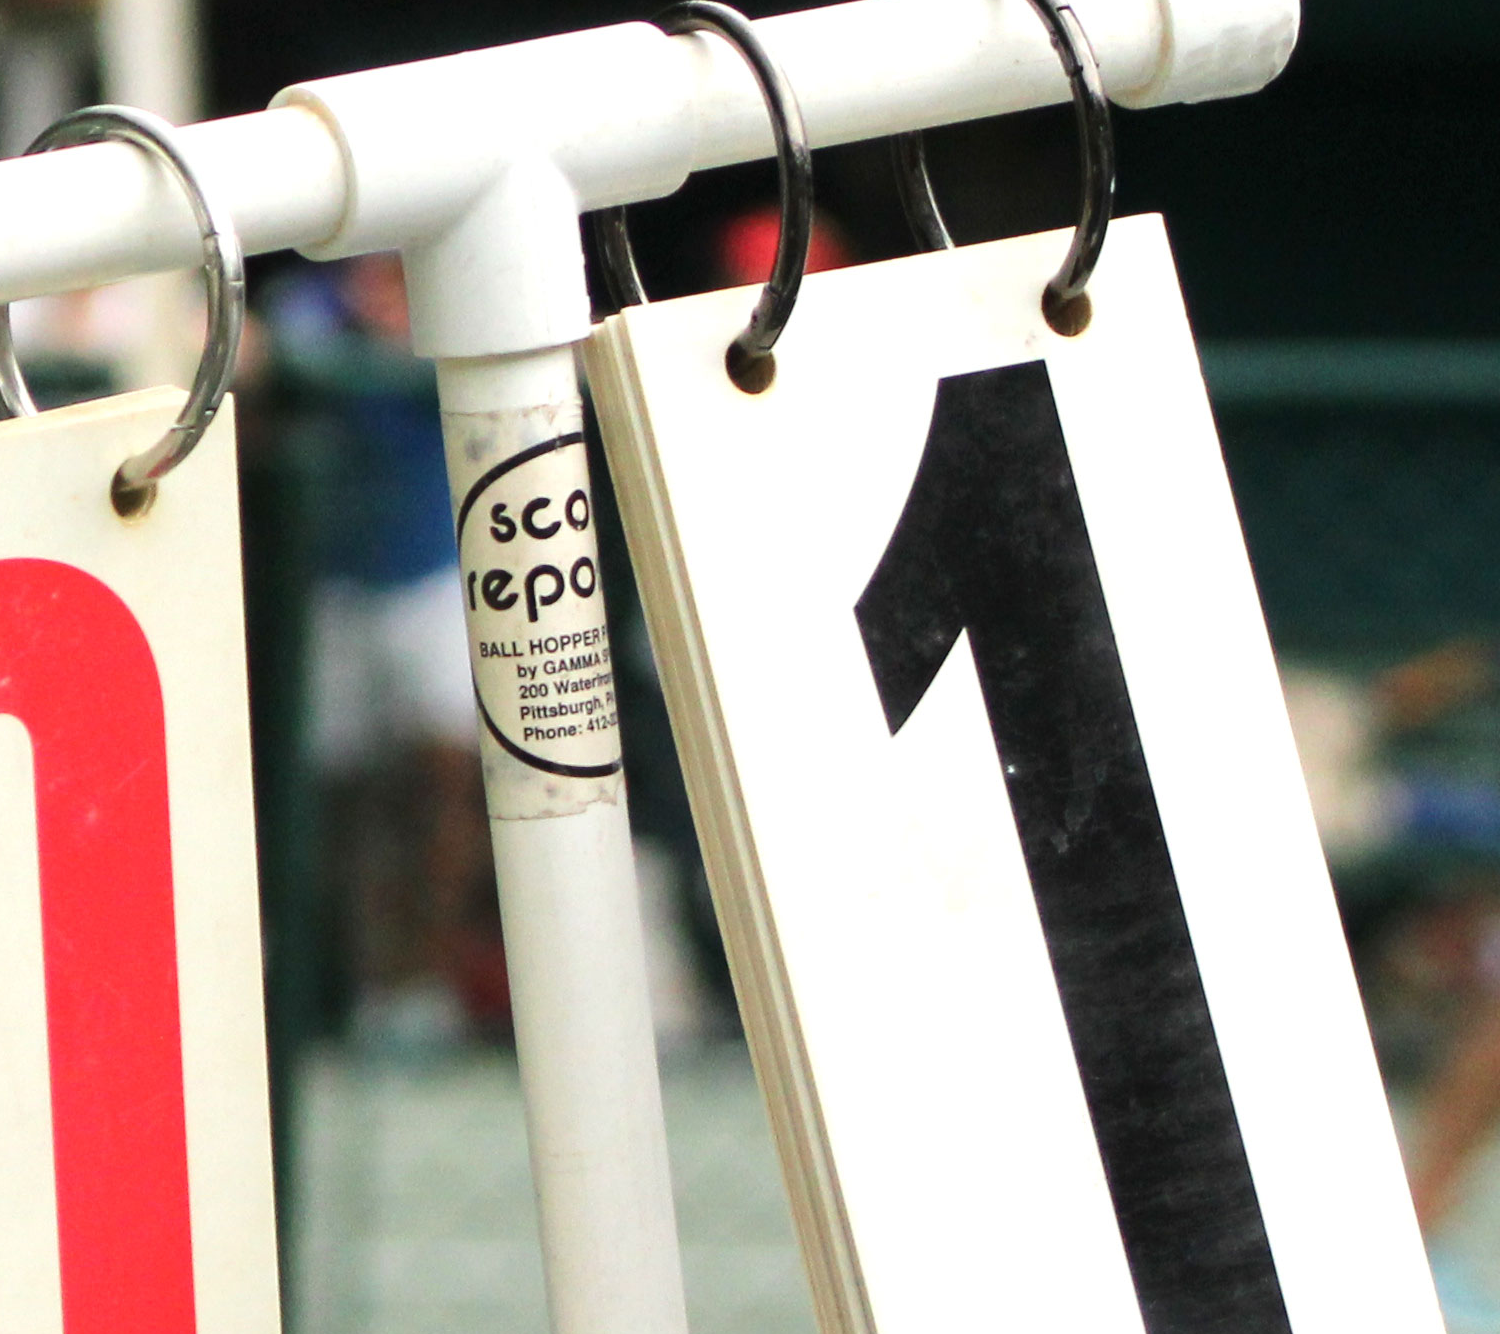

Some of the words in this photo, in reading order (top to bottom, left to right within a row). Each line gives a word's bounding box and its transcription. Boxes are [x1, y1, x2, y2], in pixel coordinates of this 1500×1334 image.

[480, 641, 524, 658] BALL
[529, 628, 600, 656] HOPPER
[516, 665, 538, 680] by
[543, 652, 601, 675] GAMMA
[519, 683, 549, 700] 200
[521, 695, 605, 720] Pittsburgh,
[524, 723, 583, 742] Phone:
